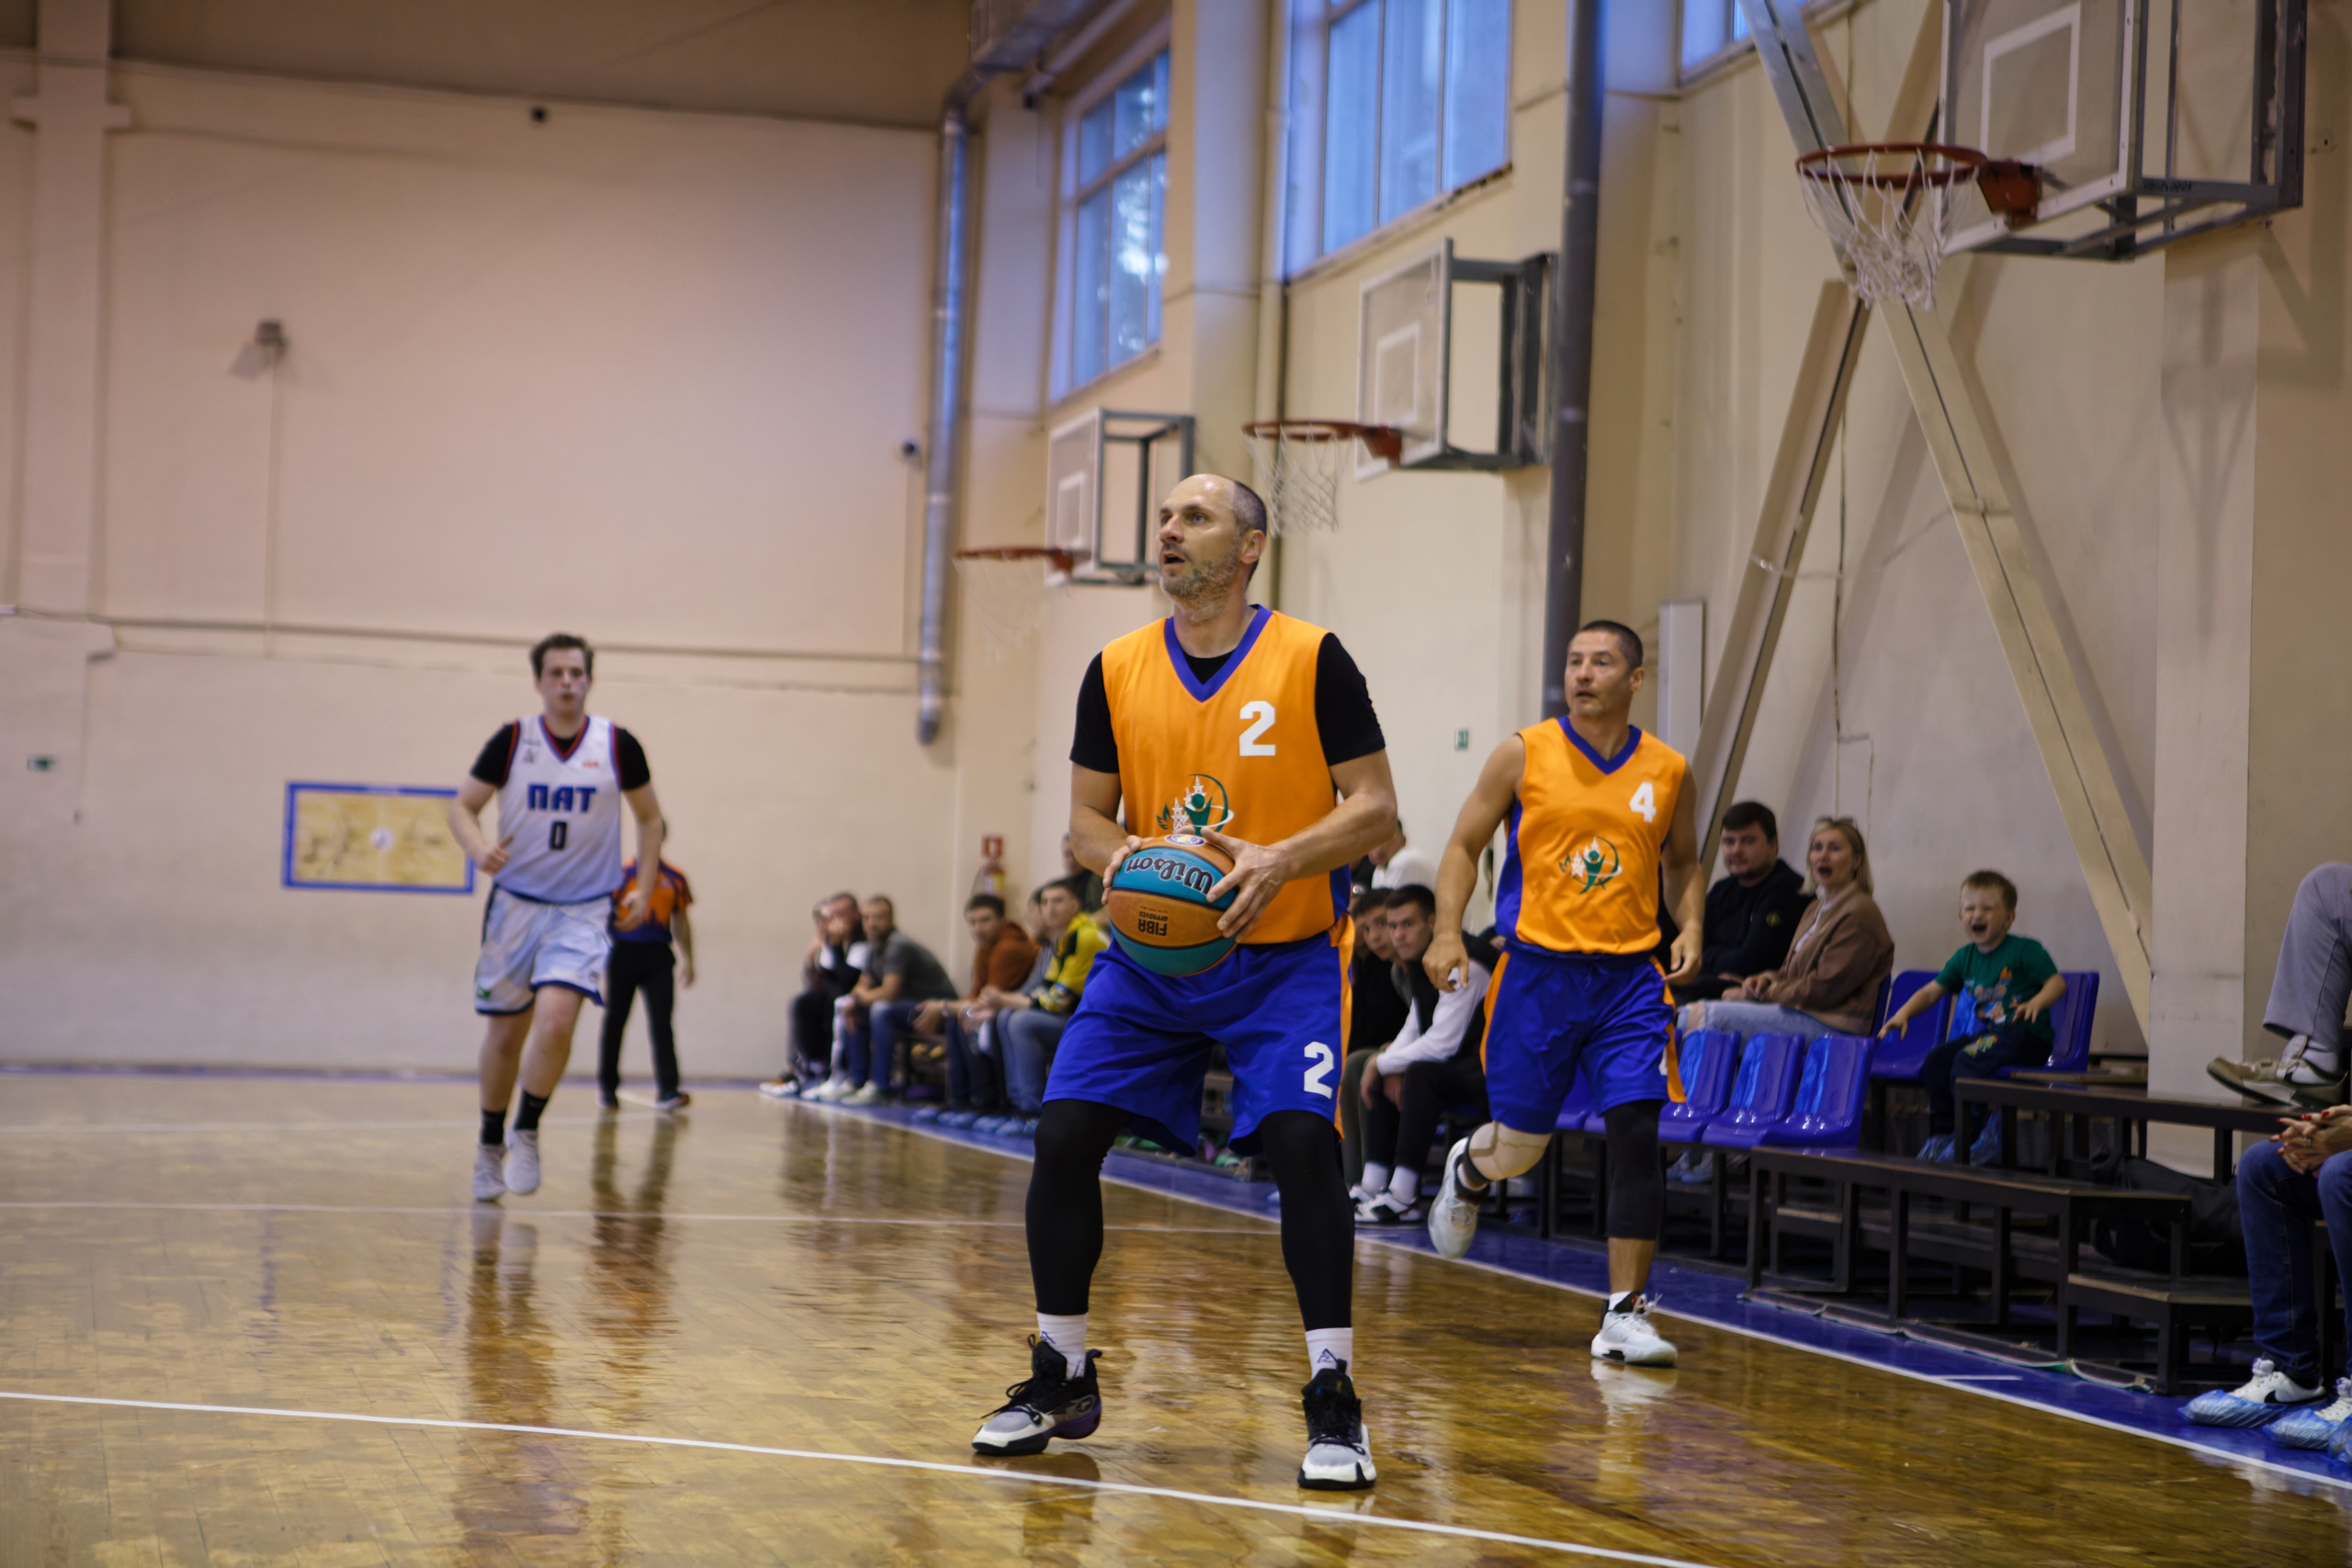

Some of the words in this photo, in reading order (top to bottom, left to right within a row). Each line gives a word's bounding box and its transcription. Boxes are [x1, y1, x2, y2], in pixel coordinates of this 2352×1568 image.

[1239, 701, 1275, 756] 2
[527, 784, 596, 812] ПАТ
[1629, 781, 1657, 823] 4
[549, 821, 567, 850] 0
[1125, 857, 1213, 896] Wilson
[1137, 919, 1168, 936] FIBA
[1138, 911, 1168, 921] APPROVED
[1304, 1041, 1334, 1100] 2
